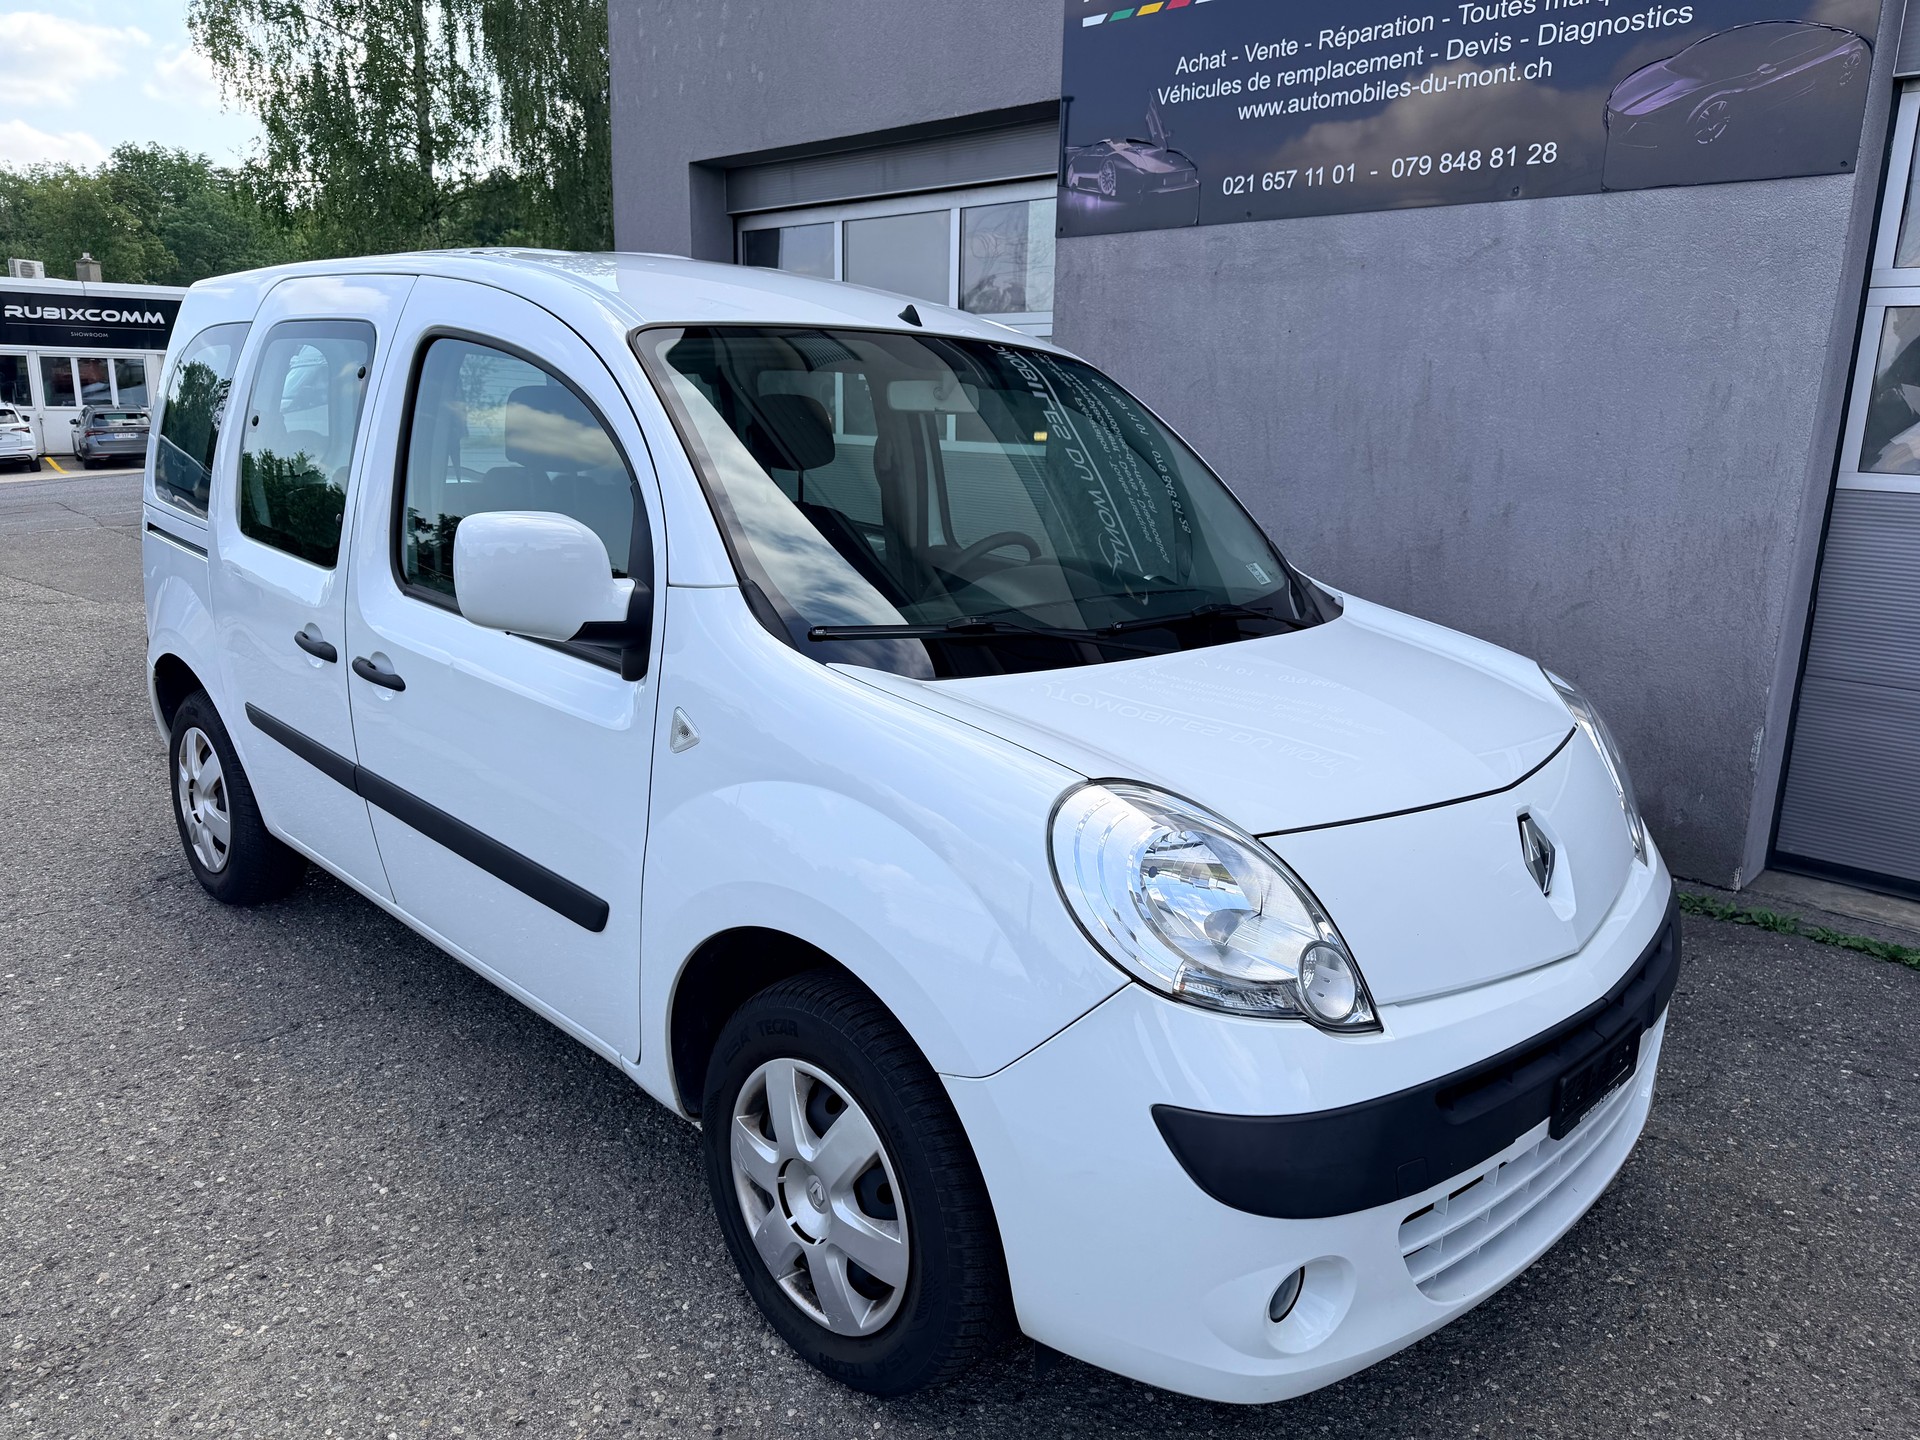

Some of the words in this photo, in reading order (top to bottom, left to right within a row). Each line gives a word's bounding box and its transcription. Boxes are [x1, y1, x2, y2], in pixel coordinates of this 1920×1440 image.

[1157, 78, 1242, 106] Véhicules
[1247, 71, 1271, 92] de
[1276, 46, 1425, 88] remplacement
[1446, 32, 1512, 61] Devis
[1537, 5, 1694, 47] Diagnostics
[1175, 50, 1227, 76] Achat
[1244, 39, 1299, 63] Vente
[1318, 14, 1434, 53] Réparation
[1458, 0, 1537, 25] Toutes
[1237, 57, 1553, 121] www.automobiles-du-mont.ch
[1222, 174, 1255, 196] 021
[1261, 169, 1298, 192] 657
[1305, 166, 1324, 187] 11
[1332, 162, 1355, 185] 01
[1391, 154, 1432, 179] 079
[1438, 149, 1482, 174] 848
[1489, 145, 1517, 169] 81
[1525, 141, 1558, 166] 28
[4, 304, 166, 325] RUBIXCOMM
